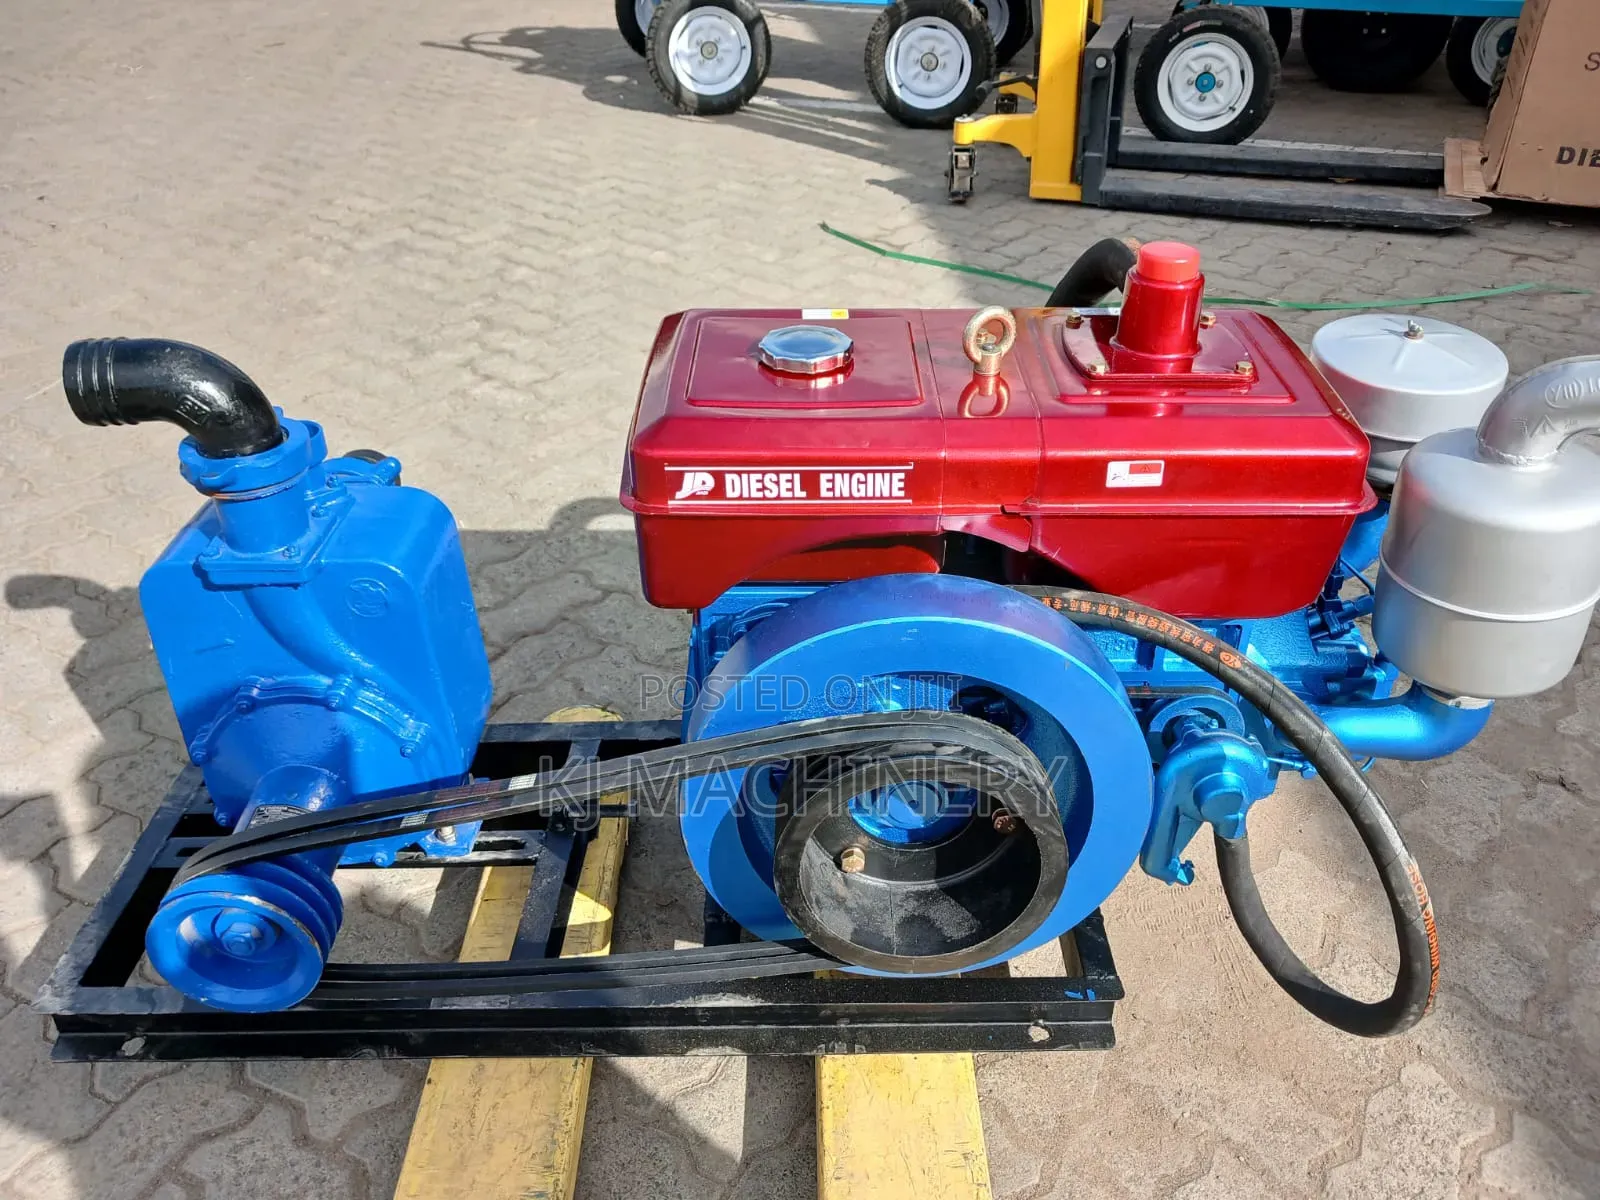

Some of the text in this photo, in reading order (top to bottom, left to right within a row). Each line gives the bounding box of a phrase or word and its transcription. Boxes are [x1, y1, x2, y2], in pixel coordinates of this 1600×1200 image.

[725, 473, 807, 499] DIESEL
[819, 472, 906, 498] ENGINE
[1407, 864, 1429, 907] HOSE
[1422, 909, 1440, 969] WINDING
